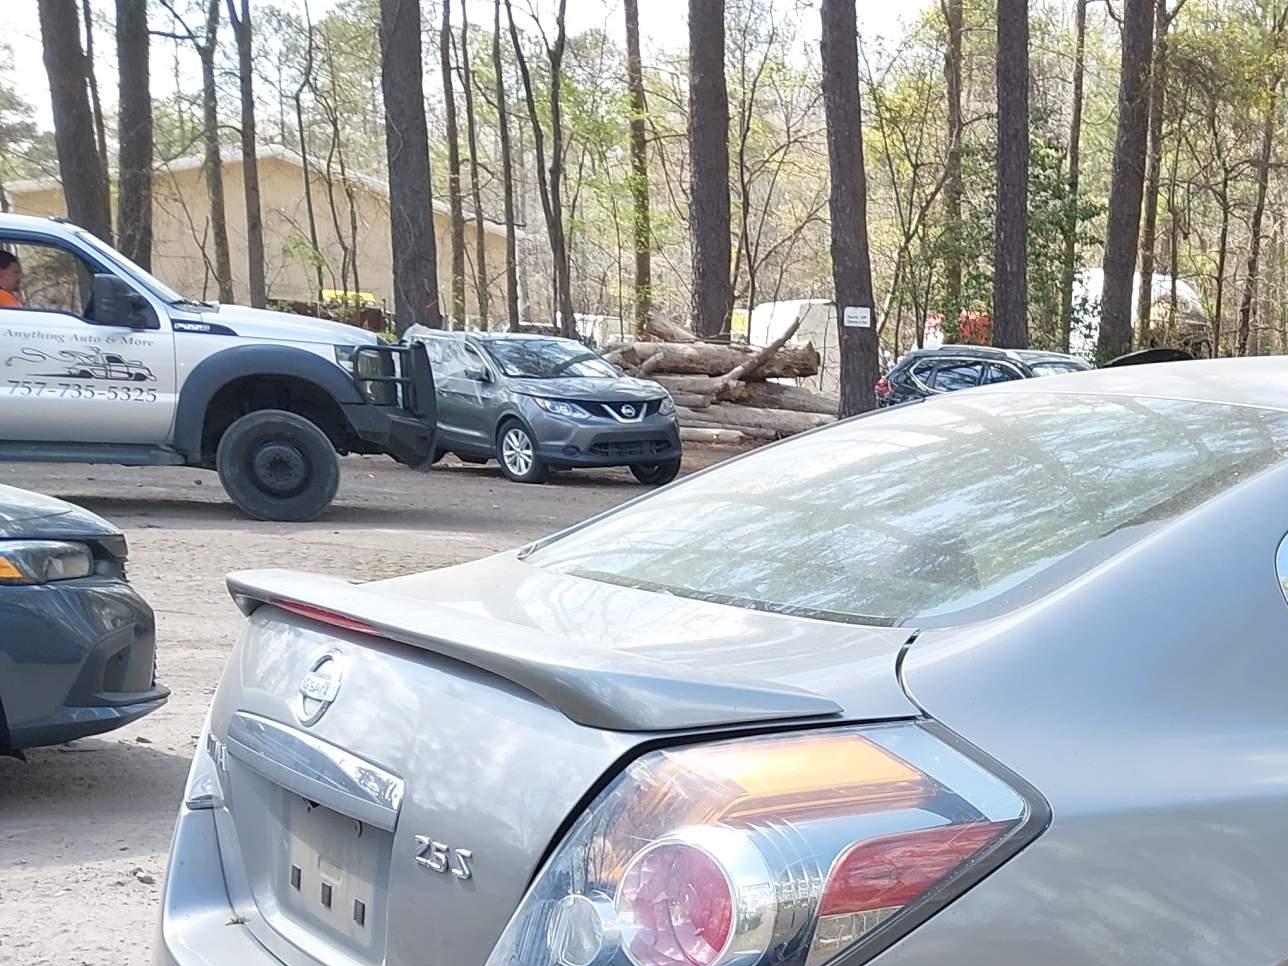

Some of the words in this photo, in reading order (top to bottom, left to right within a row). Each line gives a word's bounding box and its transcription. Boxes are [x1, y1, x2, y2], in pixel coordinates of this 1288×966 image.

[3, 328, 66, 343] Anything
[69, 333, 101, 343] Auto
[105, 335, 116, 344] &
[120, 335, 155, 347] More
[8, 379, 158, 403] 757-735-5325
[451, 848, 473, 879] S
